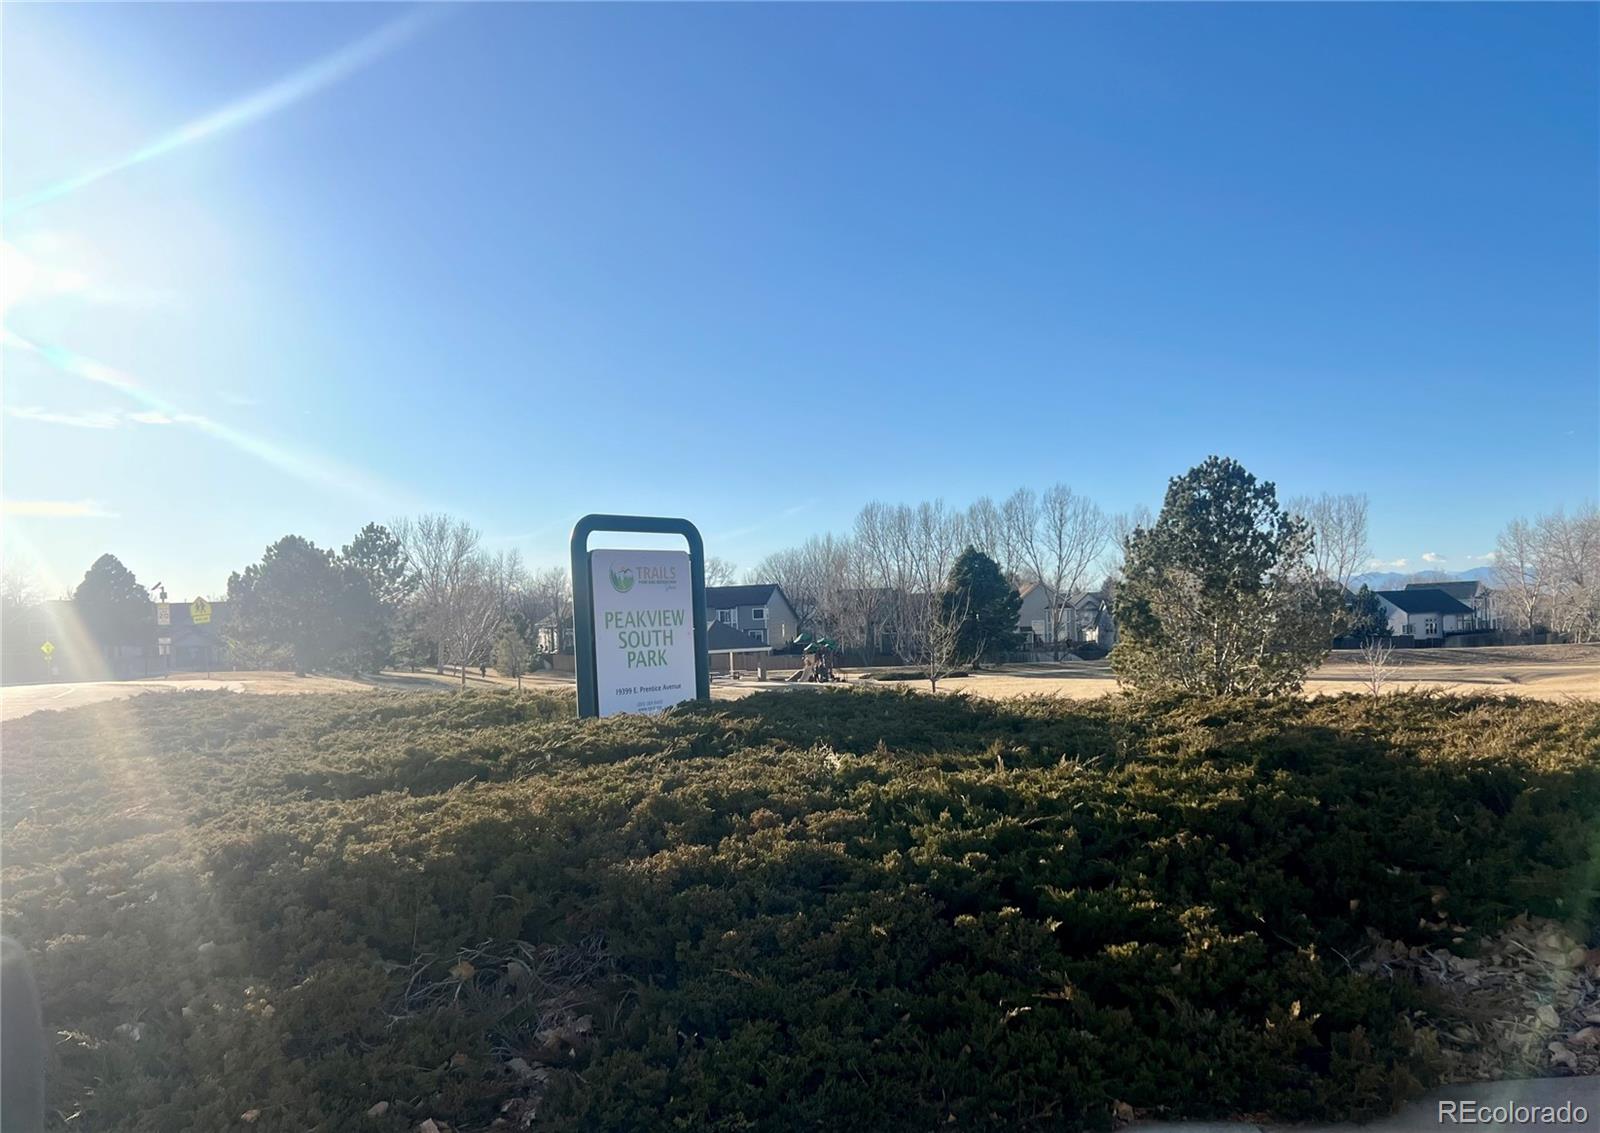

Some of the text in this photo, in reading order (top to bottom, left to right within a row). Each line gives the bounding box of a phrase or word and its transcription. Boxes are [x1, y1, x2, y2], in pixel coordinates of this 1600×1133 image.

[635, 566, 676, 580] TRAILS
[605, 608, 684, 629] PEAKVIEW
[618, 629, 673, 649] SOUTH
[628, 650, 668, 669] PARK
[616, 687, 632, 696] 19399
[640, 685, 661, 694] Prentice
[662, 683, 681, 691] Avenue
